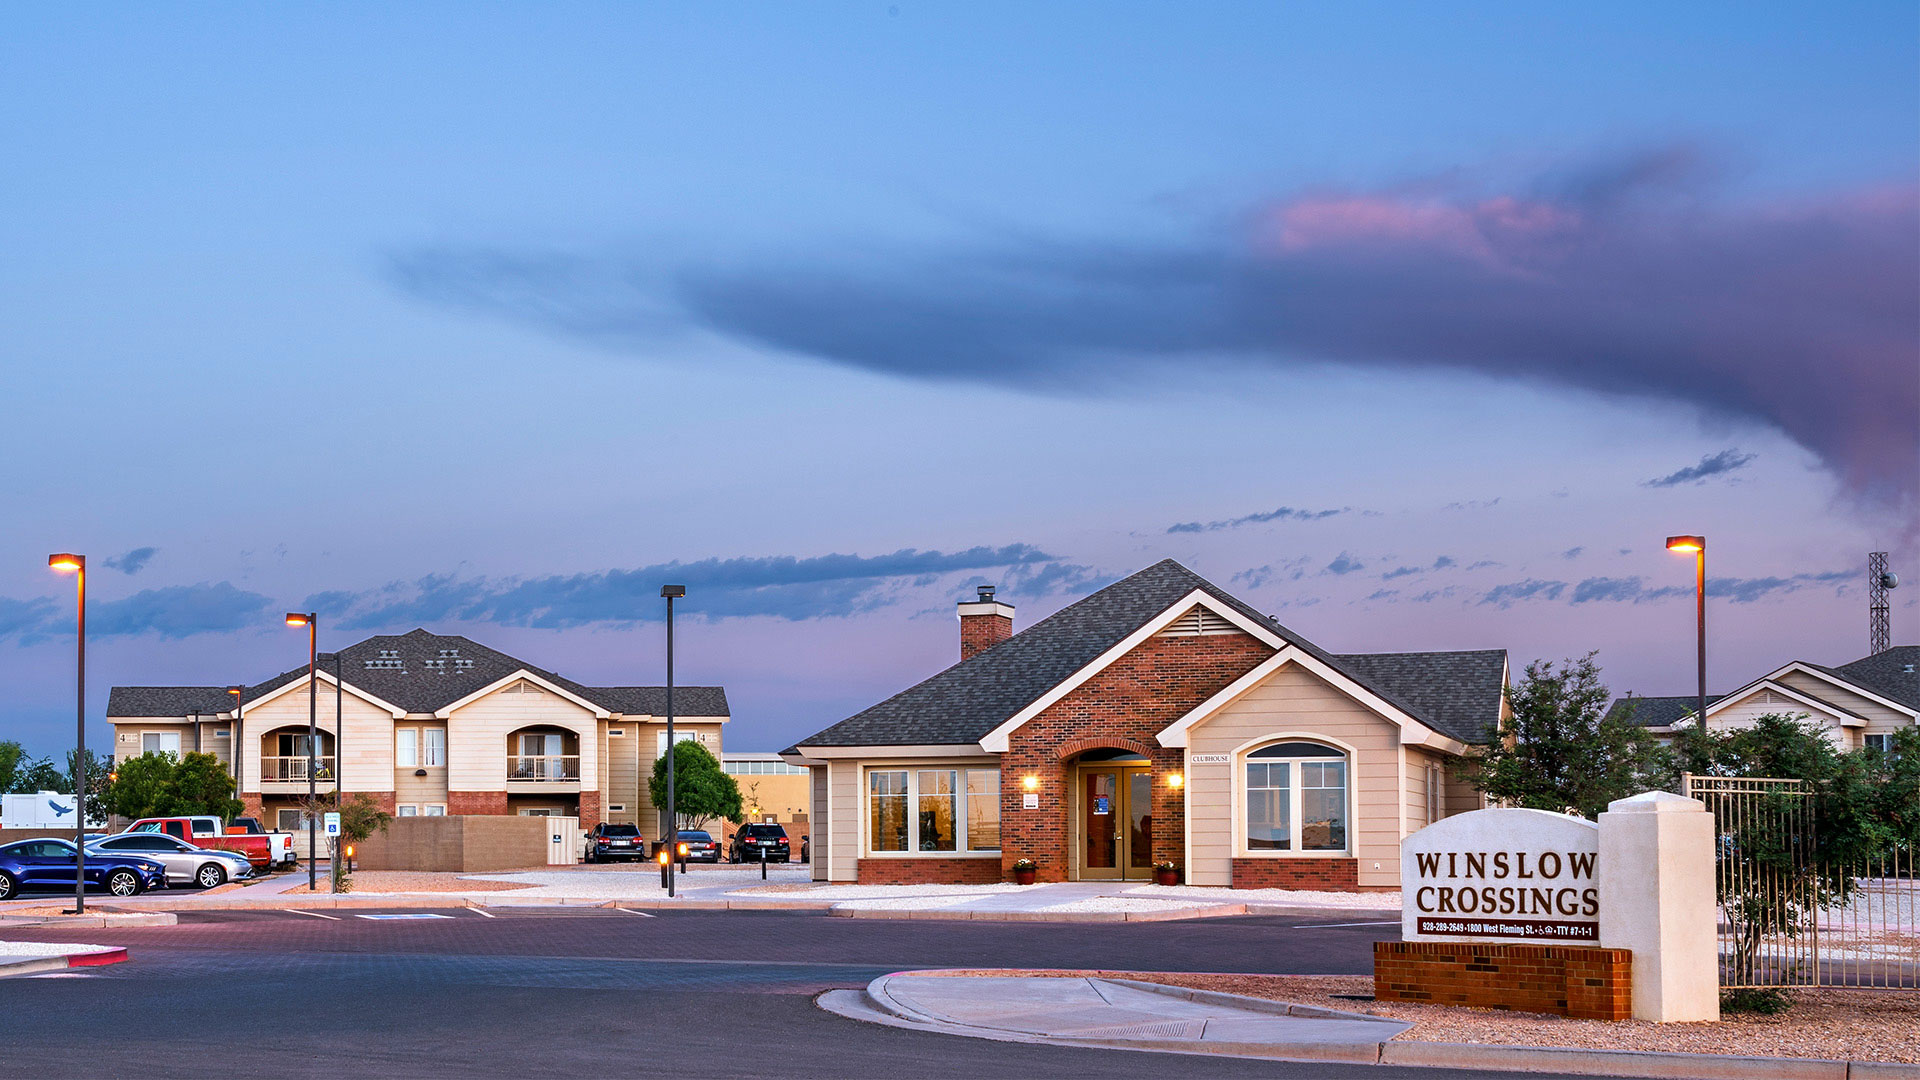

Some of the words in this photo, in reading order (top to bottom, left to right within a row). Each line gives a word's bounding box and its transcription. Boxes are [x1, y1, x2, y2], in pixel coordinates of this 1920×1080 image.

[1416, 852, 1597, 879] WINSLOW
[1416, 886, 1599, 916] CROSSINGS
[1422, 922, 1464, 932] 928-289-2649
[1467, 923, 1482, 932] 1800
[1483, 924, 1498, 933] West
[1500, 924, 1524, 936] Fleming
[1525, 924, 1535, 935] St.
[1557, 925, 1569, 935] TTY
[1570, 926, 1592, 936] #7-1-1
